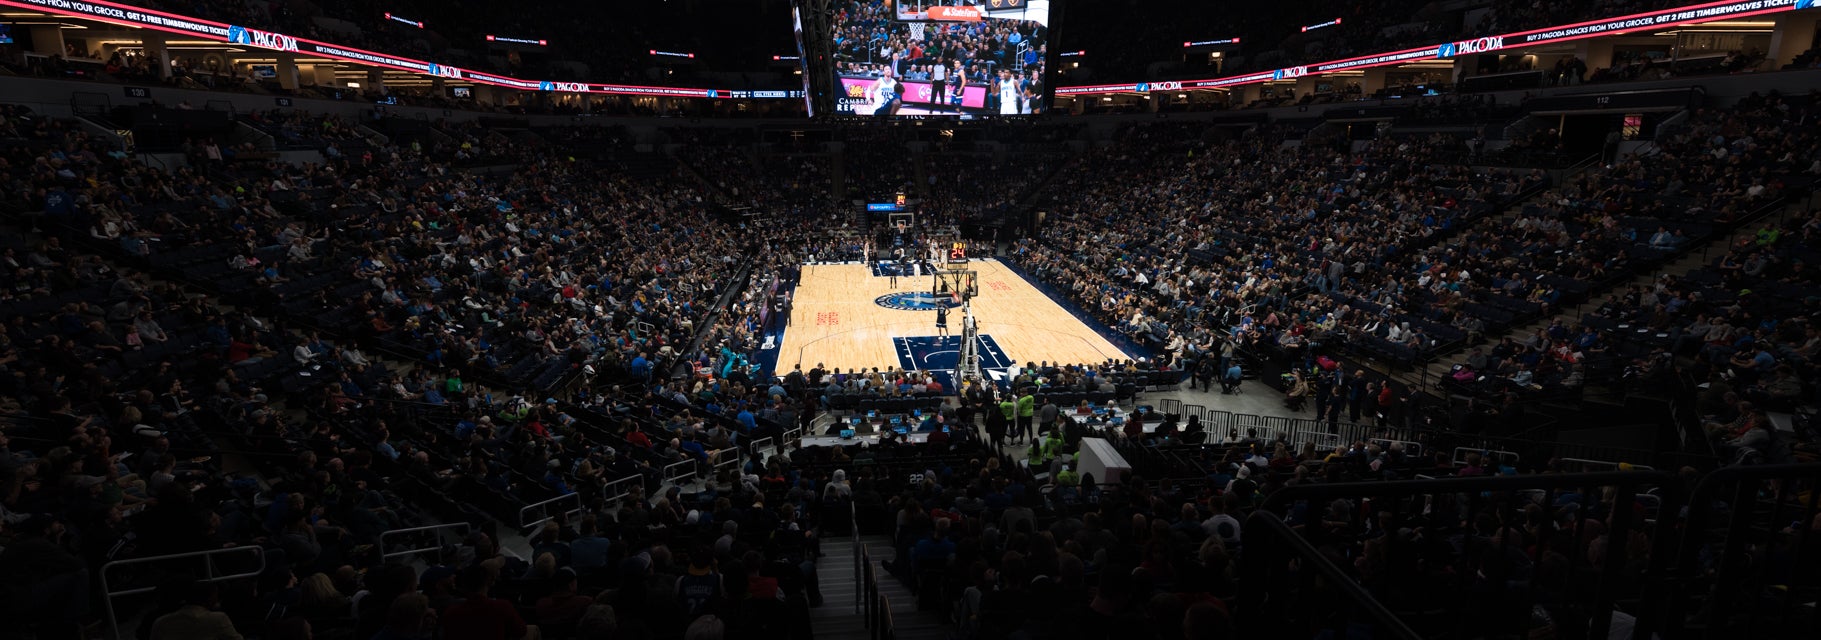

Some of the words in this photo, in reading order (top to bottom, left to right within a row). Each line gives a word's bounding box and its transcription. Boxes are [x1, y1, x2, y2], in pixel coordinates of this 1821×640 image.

[48, 0, 70, 8] FROM
[71, 2, 93, 12] YOUR
[94, 6, 126, 19] GROCER,
[127, 12, 141, 20] GET
[147, 14, 162, 24] FREE
[162, 17, 208, 32] TIMBERWOLVES
[209, 26, 230, 36] TICKETS
[1542, 30, 1565, 40] PAGODA
[1565, 27, 1588, 37] SNACKS
[1589, 25, 1607, 33] FROM
[1607, 22, 1625, 30] YOUR
[1626, 17, 1654, 27] GROCER,
[1656, 15, 1671, 23] GET
[1671, 13, 1677, 21] 2
[1677, 11, 1695, 20] FREE
[1696, 2, 1762, 17] TIMBERWOLVES
[253, 30, 299, 52] PAGODA
[1458, 36, 1504, 54] PAGODA
[440, 65, 462, 79] PAGODA
[1284, 66, 1307, 78] PAGODA
[556, 82, 590, 92] PAGODA
[1151, 81, 1182, 90] PAGODA
[131, 88, 145, 97] 130
[1597, 96, 1609, 104] 112
[952, 248, 964, 258] 24
